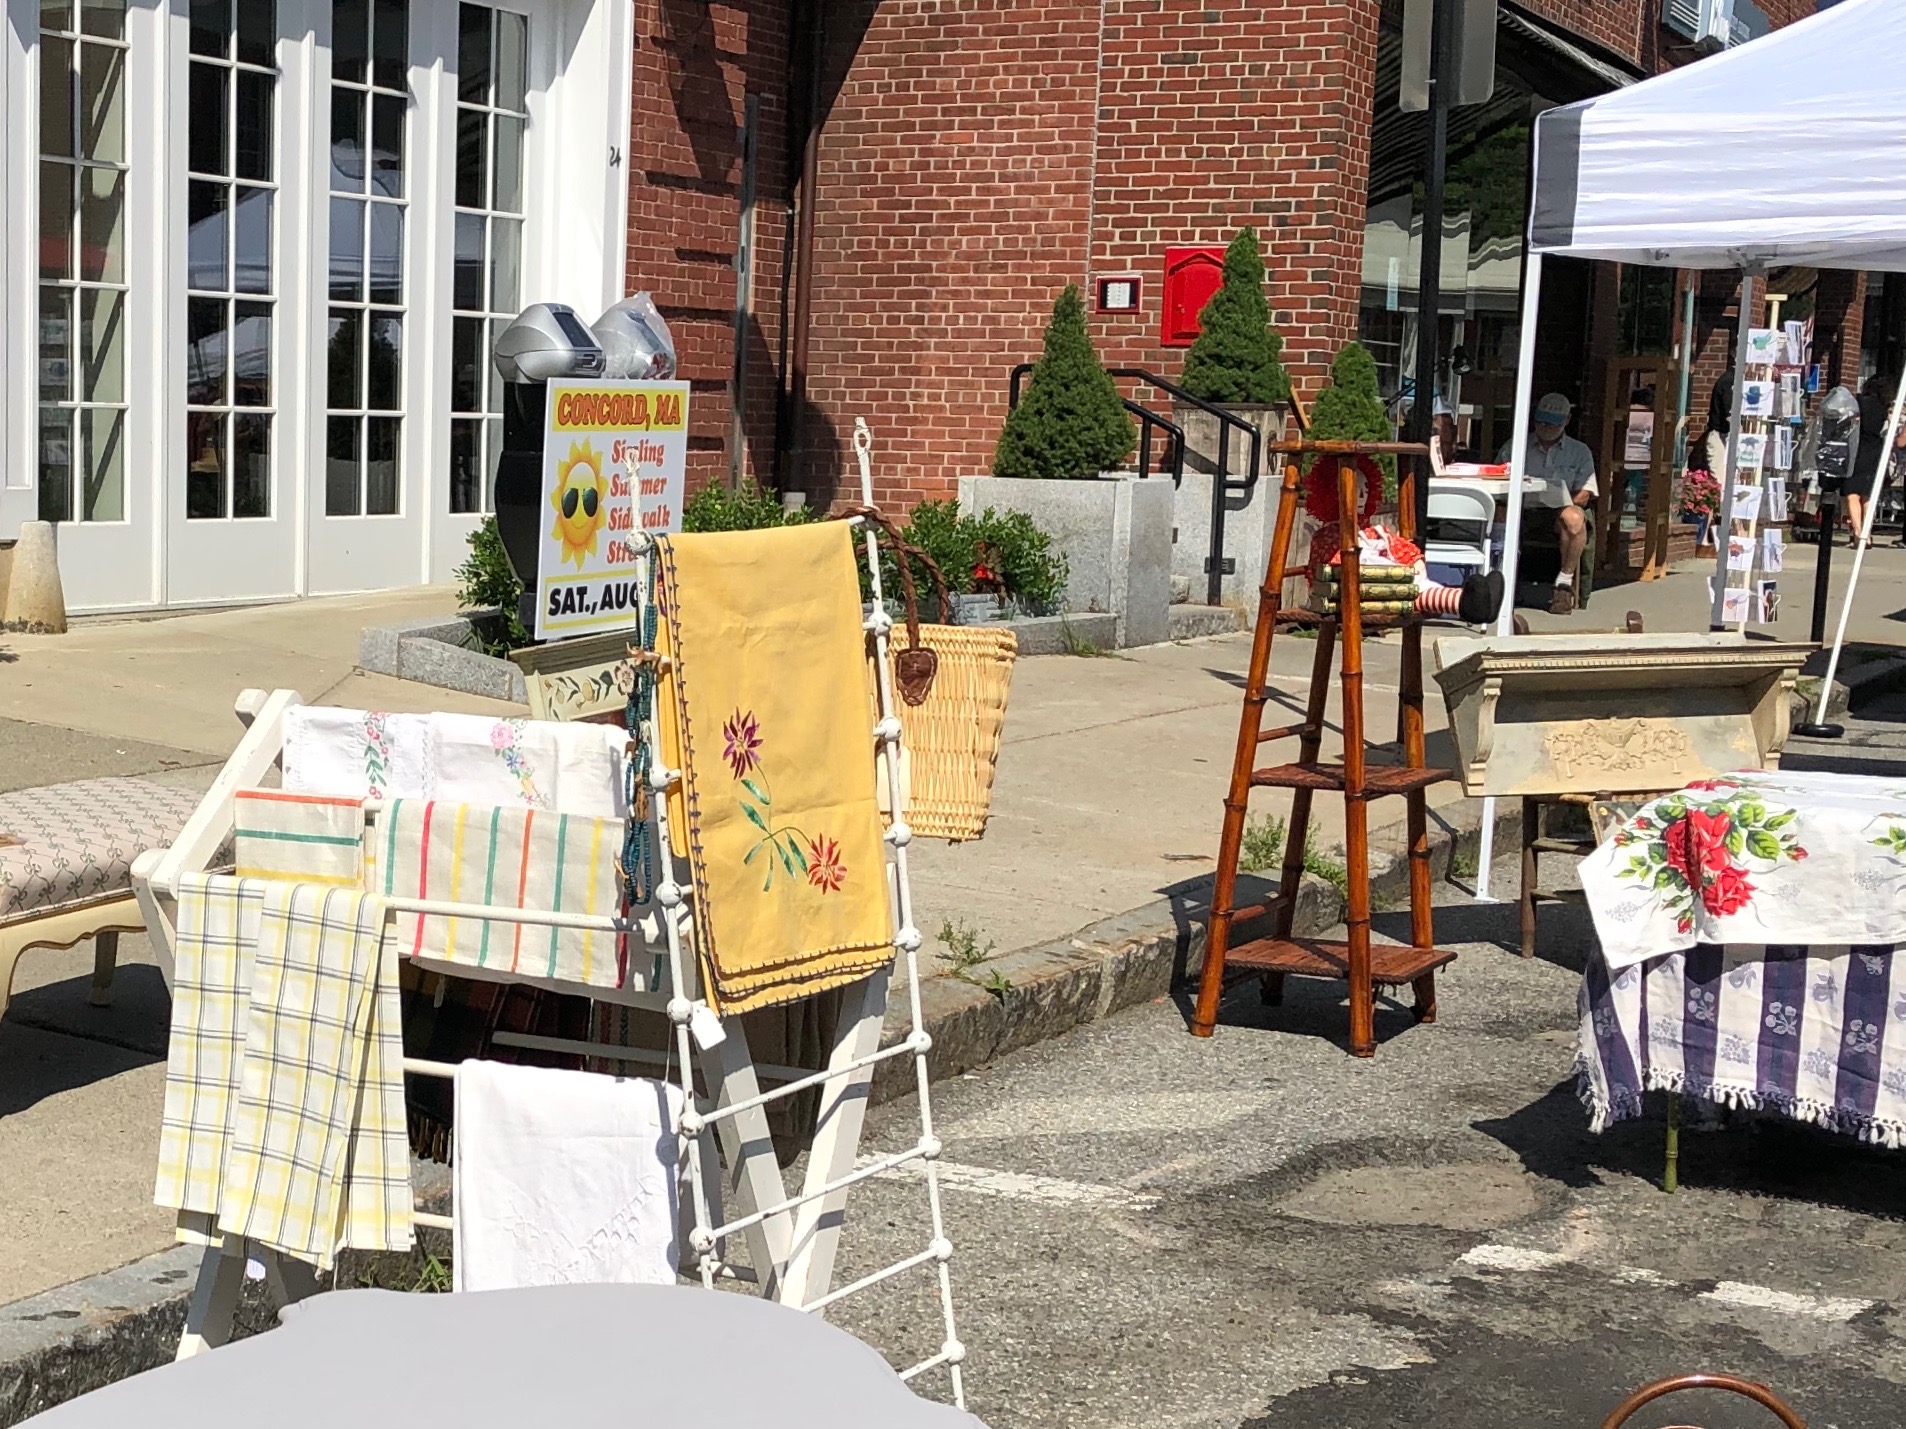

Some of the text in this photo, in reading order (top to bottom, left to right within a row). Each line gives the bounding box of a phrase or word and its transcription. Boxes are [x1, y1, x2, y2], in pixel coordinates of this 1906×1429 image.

[610, 146, 621, 169] 24
[558, 393, 680, 431] CONCORD, MA
[611, 438, 664, 467] Siling
[610, 473, 667, 497] Sumer
[548, 585, 598, 616] SAT.,
